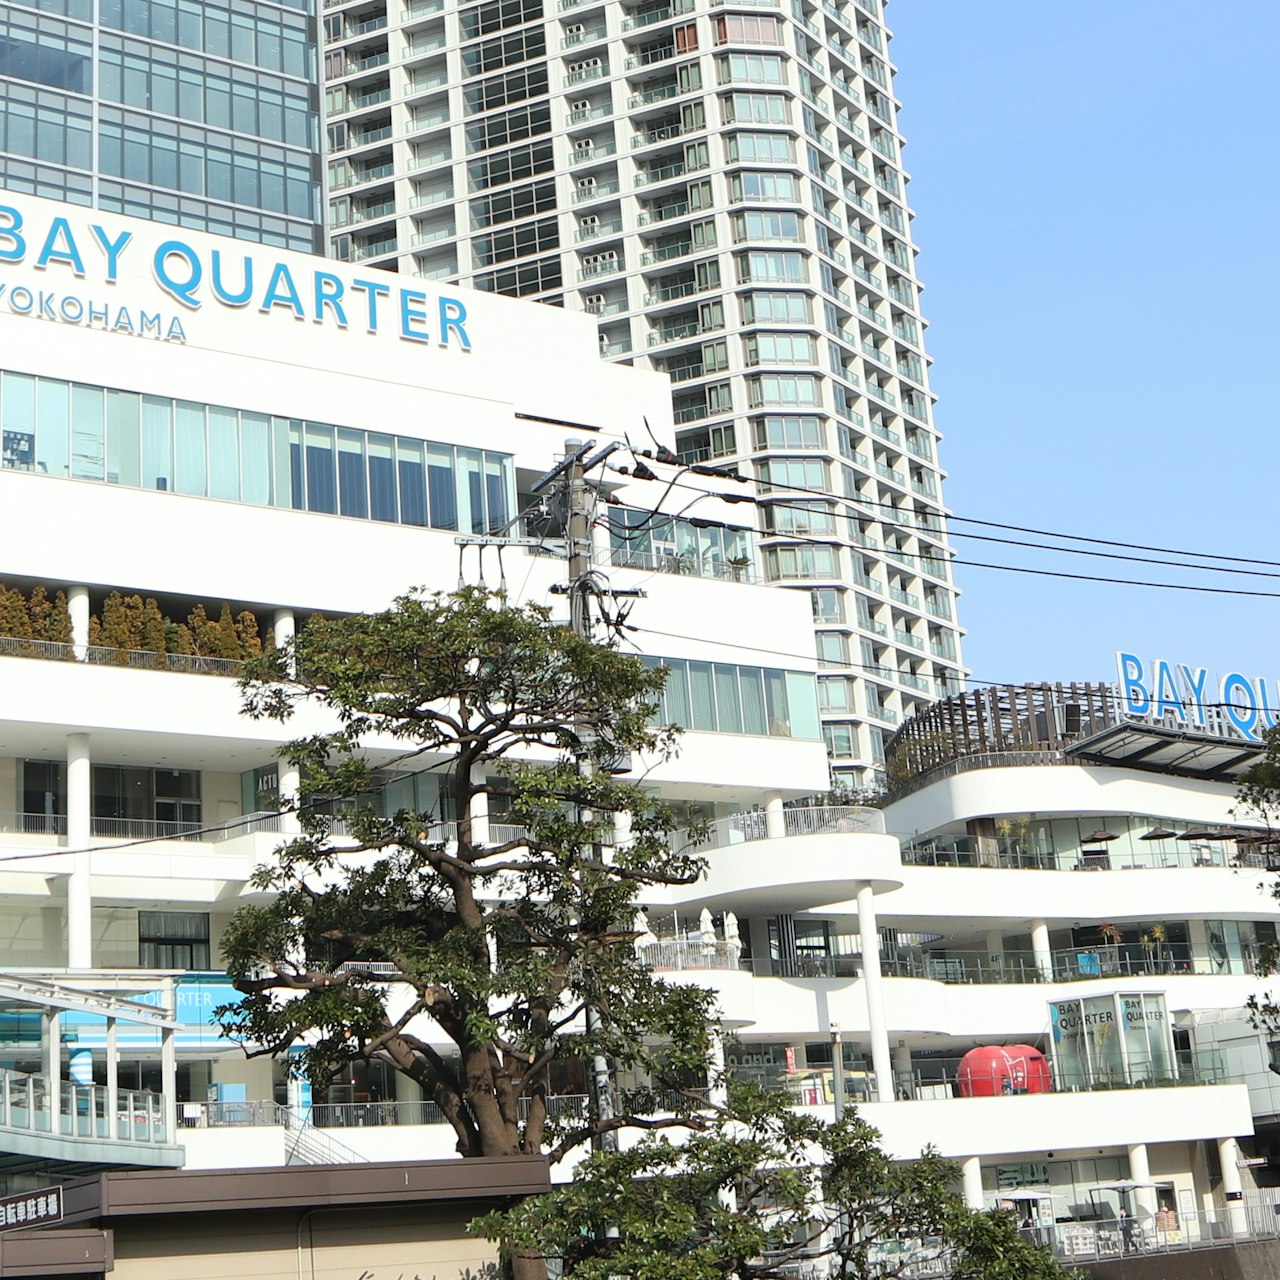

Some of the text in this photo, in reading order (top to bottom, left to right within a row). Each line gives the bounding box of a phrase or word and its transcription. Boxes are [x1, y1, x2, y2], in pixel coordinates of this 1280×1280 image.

[152, 240, 472, 354] QUARTER
[1116, 651, 1207, 726] BAY
[1059, 1001, 1080, 1015] BAY
[1125, 1000, 1140, 1009] BAY
